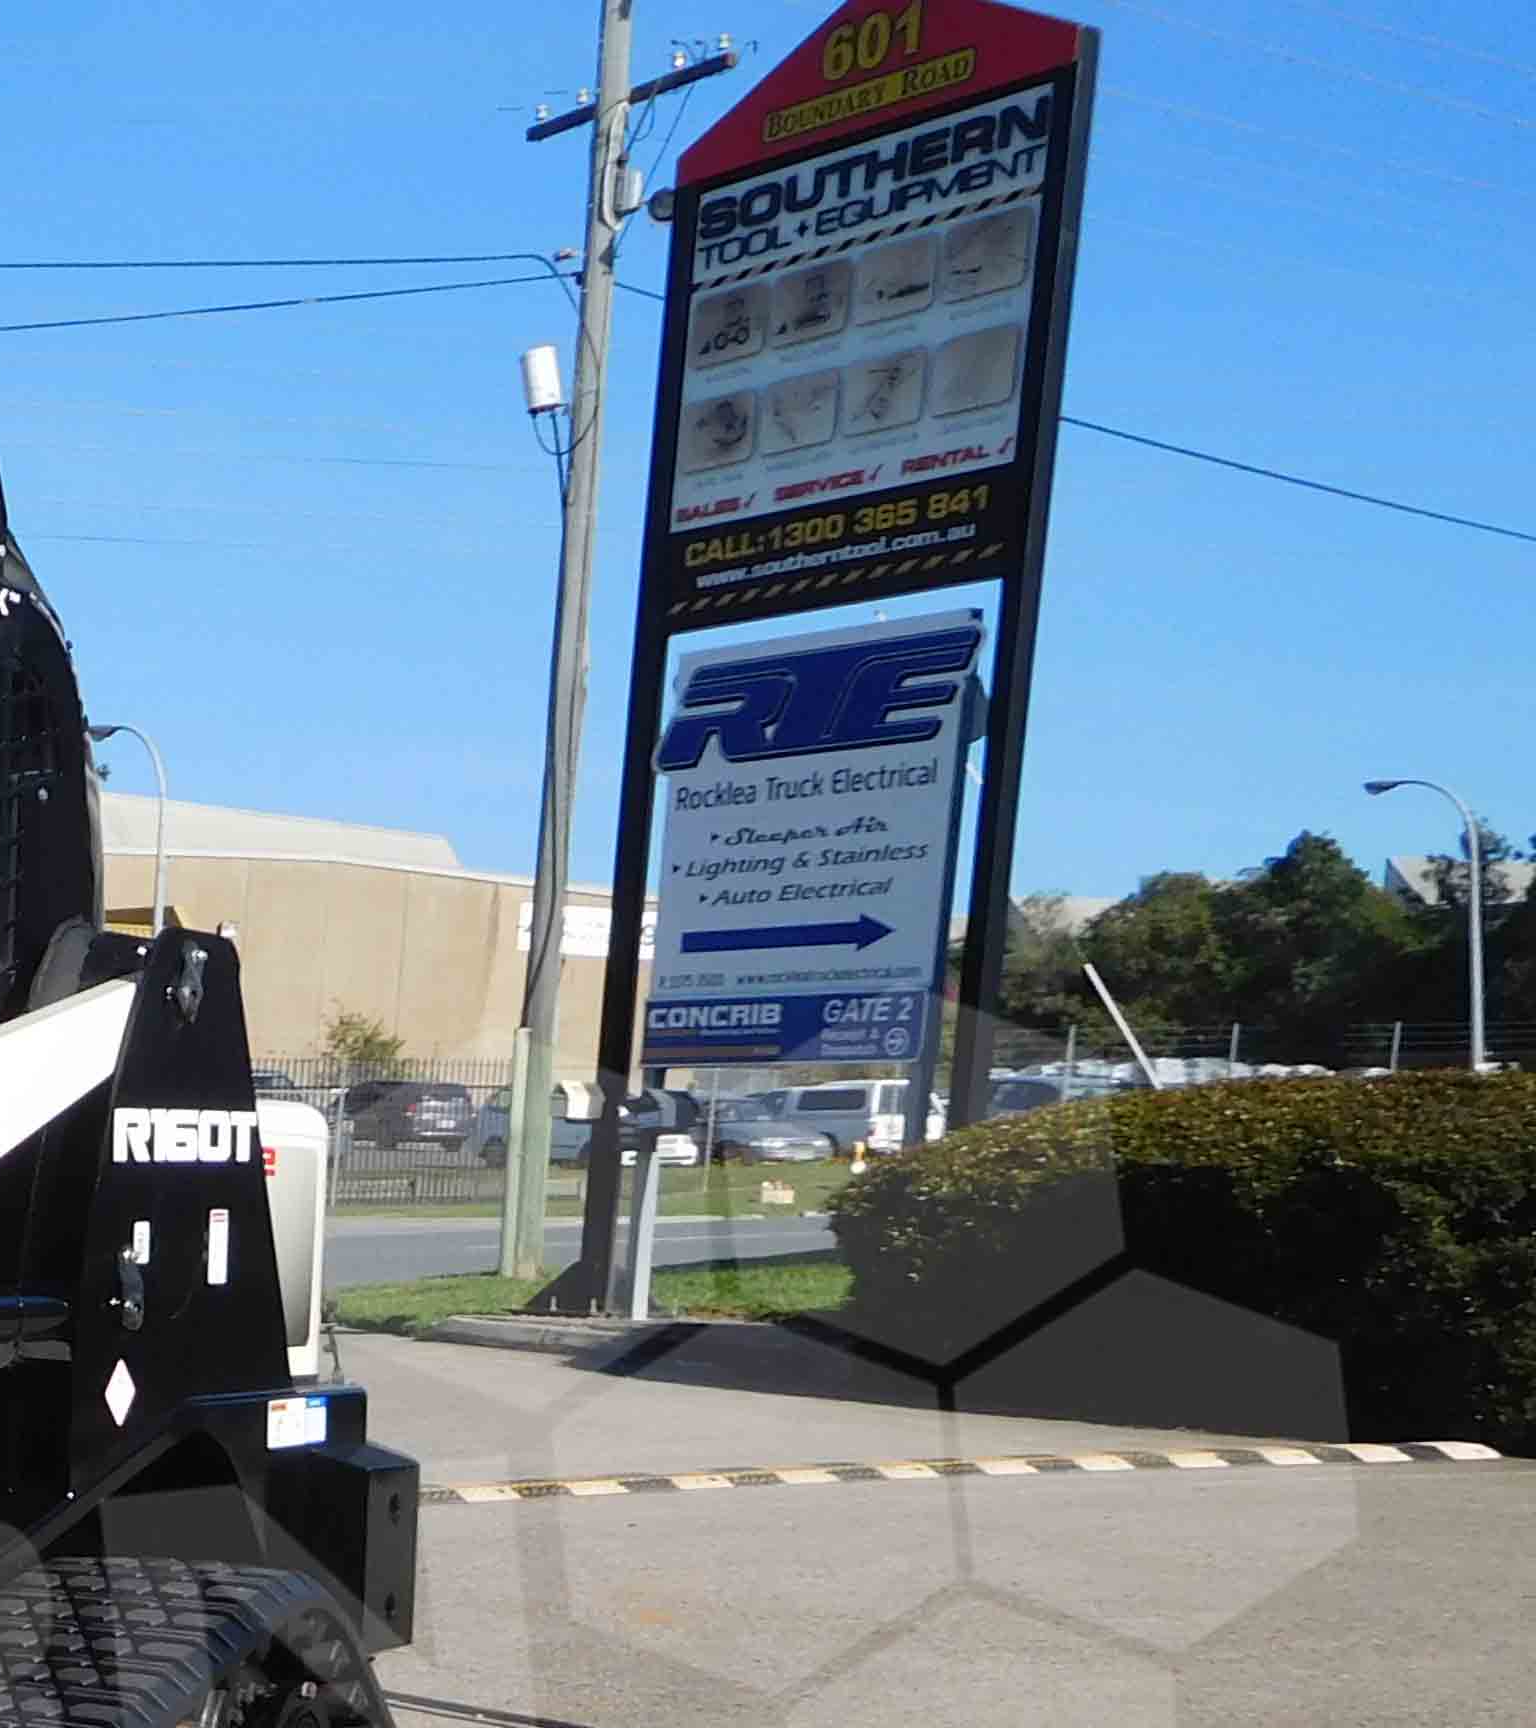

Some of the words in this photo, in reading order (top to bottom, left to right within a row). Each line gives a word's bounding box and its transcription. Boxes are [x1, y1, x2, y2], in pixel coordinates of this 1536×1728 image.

[823, 1, 922, 80] 601
[900, 56, 969, 95] ROAD
[698, 102, 1049, 240] SOUTHERN
[698, 228, 791, 270] TOOL
[815, 144, 1047, 237] EQUIPMENT
[901, 443, 990, 476] RENTAL
[853, 498, 919, 534] 365
[926, 485, 990, 519] 841
[674, 780, 757, 811] Rocklea
[766, 771, 825, 801] Truck
[832, 759, 938, 795] Electrical
[724, 826, 828, 845] Sleeper
[685, 855, 785, 881] Lighting
[792, 851, 809, 868] &
[818, 843, 929, 868] Stainless
[712, 887, 771, 906] Auto
[778, 877, 895, 902] Electrical
[648, 1004, 782, 1029] CONCRIB
[823, 997, 892, 1023] GATE
[896, 996, 913, 1021] 2
